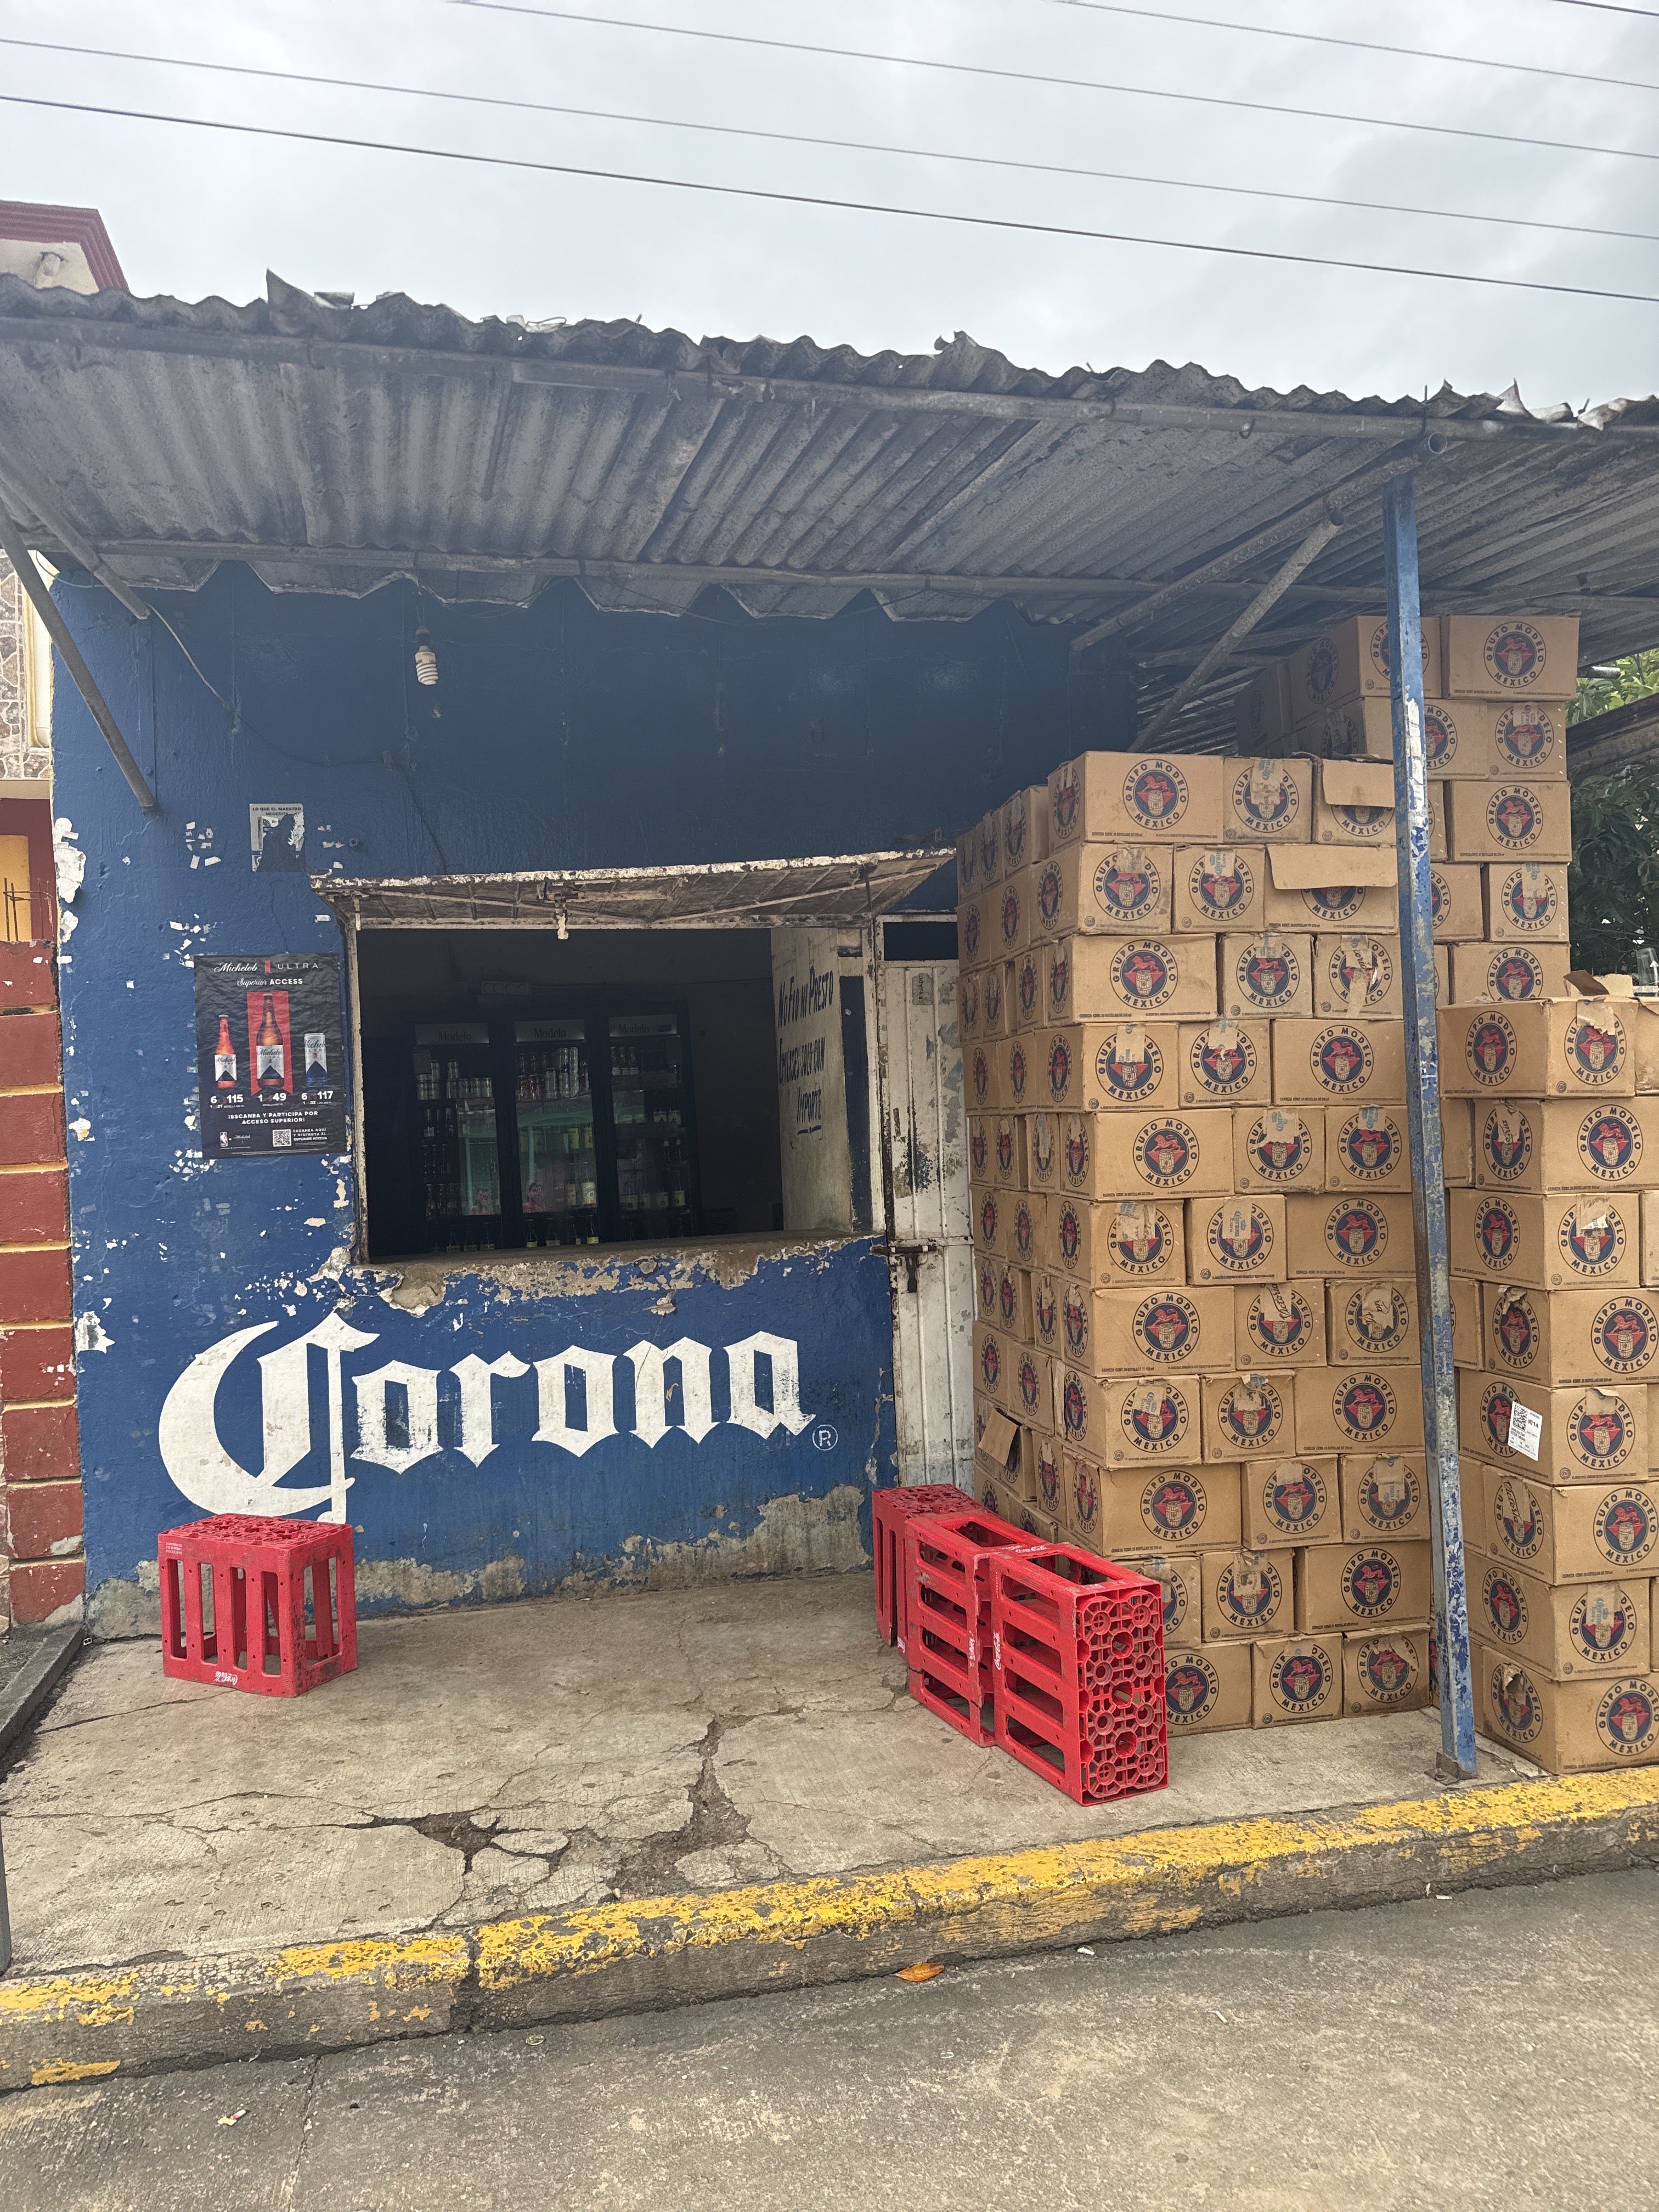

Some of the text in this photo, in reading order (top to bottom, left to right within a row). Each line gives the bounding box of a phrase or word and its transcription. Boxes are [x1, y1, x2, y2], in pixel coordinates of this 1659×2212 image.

[1486, 624, 1543, 662] GRUPO MODELO
[1494, 671, 1536, 685] MEXICO
[1506, 752, 1546, 766] MEXICO
[1125, 761, 1186, 802] GRUPO MODELO
[1488, 788, 1541, 824] GRUPO MODELO
[1135, 812, 1179, 827] MEXICO
[1245, 815, 1290, 830] MEXICO
[1497, 833, 1535, 848] MEXICO
[1105, 904, 1150, 918] MEXICO
[1201, 903, 1245, 918] MEXICO
[1512, 915, 1550, 929] MEXICO
[214, 962, 258, 973] Michelob
[1113, 941, 1175, 982] GRUPO MODELO
[1489, 950, 1541, 986] GRUPO MODELO
[237, 978, 268, 988] Superior
[1122, 991, 1169, 1007] MEXICO
[1249, 990, 1291, 1006] MEXICO
[438, 1030, 472, 1042] Modelo
[534, 1028, 566, 1039] Modelo
[618, 1023, 650, 1035] Modelo
[1466, 1013, 1514, 1057] GRUPO MODELO
[1312, 1028, 1371, 1066] GRUPO MODELO
[1474, 1066, 1509, 1084] MEXICO
[1576, 1065, 1618, 1082] MEXICO
[1108, 1083, 1154, 1099] MEXICO
[1322, 1076, 1364, 1092] MEXICO
[211, 1096, 217, 1104] 6
[258, 1094, 263, 1102] 1
[301, 1092, 308, 1101] 6
[1580, 1107, 1641, 1151] GRUPO MODELO
[1136, 1120, 1197, 1161] GRUPO MODELO
[1146, 1169, 1190, 1186] MEXICO
[1348, 1163, 1392, 1178] MEXICO
[1491, 1162, 1523, 1177] MEXICO
[1590, 1160, 1634, 1178] MEXICO
[1234, 1211, 1242, 1237] Corona
[1327, 1200, 1386, 1239] GRUPO MODELO
[1475, 1200, 1517, 1243] GRUPO MODELO
[1220, 1252, 1265, 1269] MEXICO
[1336, 1249, 1379, 1265] MEXICO
[1482, 1252, 1513, 1267] MEXICO
[1571, 1256, 1617, 1274] MEXICO
[1136, 1294, 1198, 1335] GRUPO MODELO
[1594, 1299, 1656, 1344] GRUPO MODELO
[1146, 1344, 1190, 1361] MEXICO
[1500, 1348, 1532, 1365] MEXICO
[1604, 1353, 1649, 1370] MEXICO
[1335, 1374, 1394, 1414] GRUPO MODELO
[158, 1312, 817, 1524] Corona
[1231, 1429, 1274, 1446] MEXICO
[1344, 1424, 1387, 1440] MEXICO
[1580, 1449, 1626, 1468] MEXICO
[1143, 1472, 1204, 1514] GRUPO MODELO
[1276, 1513, 1318, 1531] MEXICO
[1596, 1490, 1656, 1537] GRUPO MODELO
[1153, 1521, 1198, 1538] MEXICO
[1605, 1544, 1649, 1563] MEXICO
[1344, 1550, 1399, 1592] GRUPO MODELO
[1483, 1570, 1525, 1622] GRUPO MODELO
[1352, 1598, 1392, 1615] MEXICO
[1229, 1608, 1273, 1626] MEXICO
[1491, 1620, 1521, 1641] MEXICO
[1582, 1641, 1627, 1661] MEXICO
[1282, 1693, 1324, 1711] MEXICO
[1599, 1681, 1659, 1728] GRUPO MODELO
[1609, 1734, 1654, 1753] MEXICO
